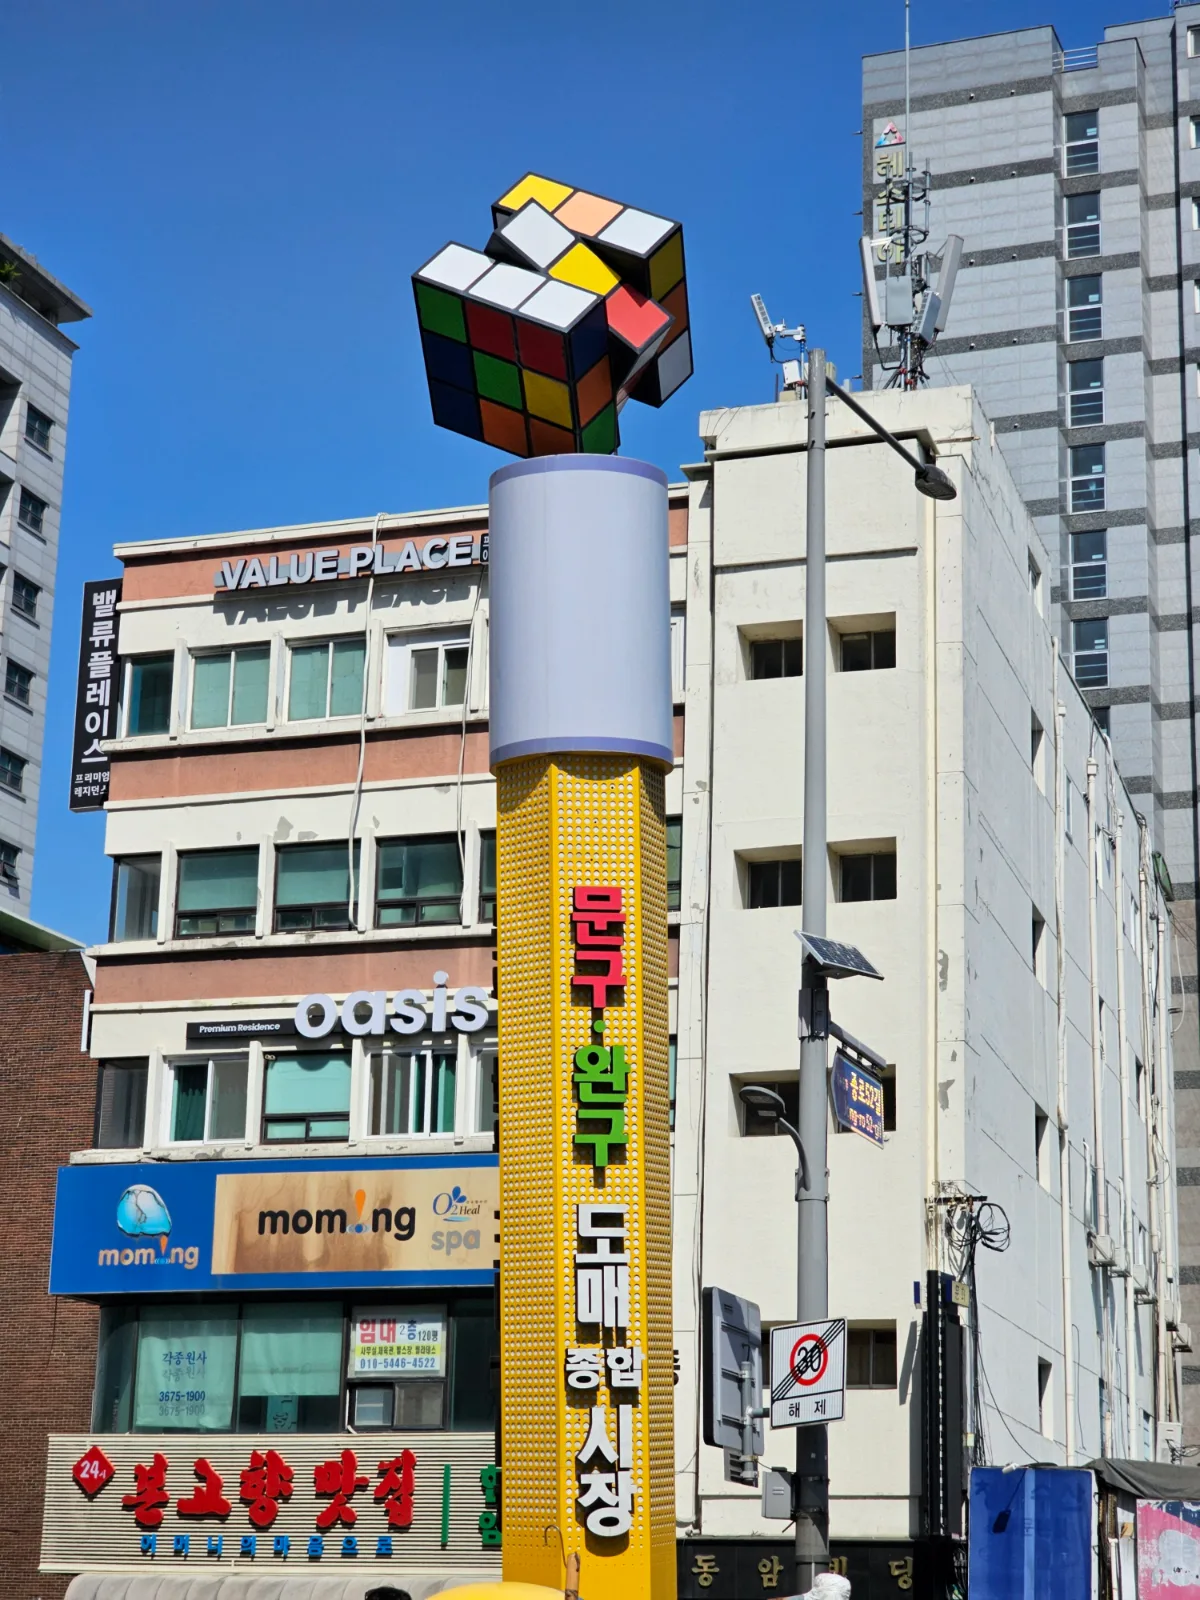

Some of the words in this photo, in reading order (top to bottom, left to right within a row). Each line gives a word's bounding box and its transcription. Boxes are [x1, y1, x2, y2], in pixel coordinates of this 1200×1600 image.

[221, 549, 340, 590] VALUE
[349, 535, 474, 577] PLACE
[81, 589, 117, 763] 밸류플레이스
[74, 771, 110, 783] 프리미엄
[294, 970, 489, 1038] oasis
[199, 1024, 237, 1033] Premium
[238, 1022, 281, 1032] Residence
[459, 1205, 480, 1215] Heal
[431, 1229, 480, 1256] spa
[575, 1203, 630, 1328] 도매
[360, 1319, 397, 1344] 임대
[400, 1320, 417, 1340] 2층
[418, 1330, 438, 1342] 120평
[360, 1358, 435, 1369] 010-5446-4522
[566, 1347, 645, 1389] 종합
[159, 1391, 206, 1402] 3675-1900
[577, 1404, 637, 1537] 시장
[314, 1448, 417, 1528] 맛집
